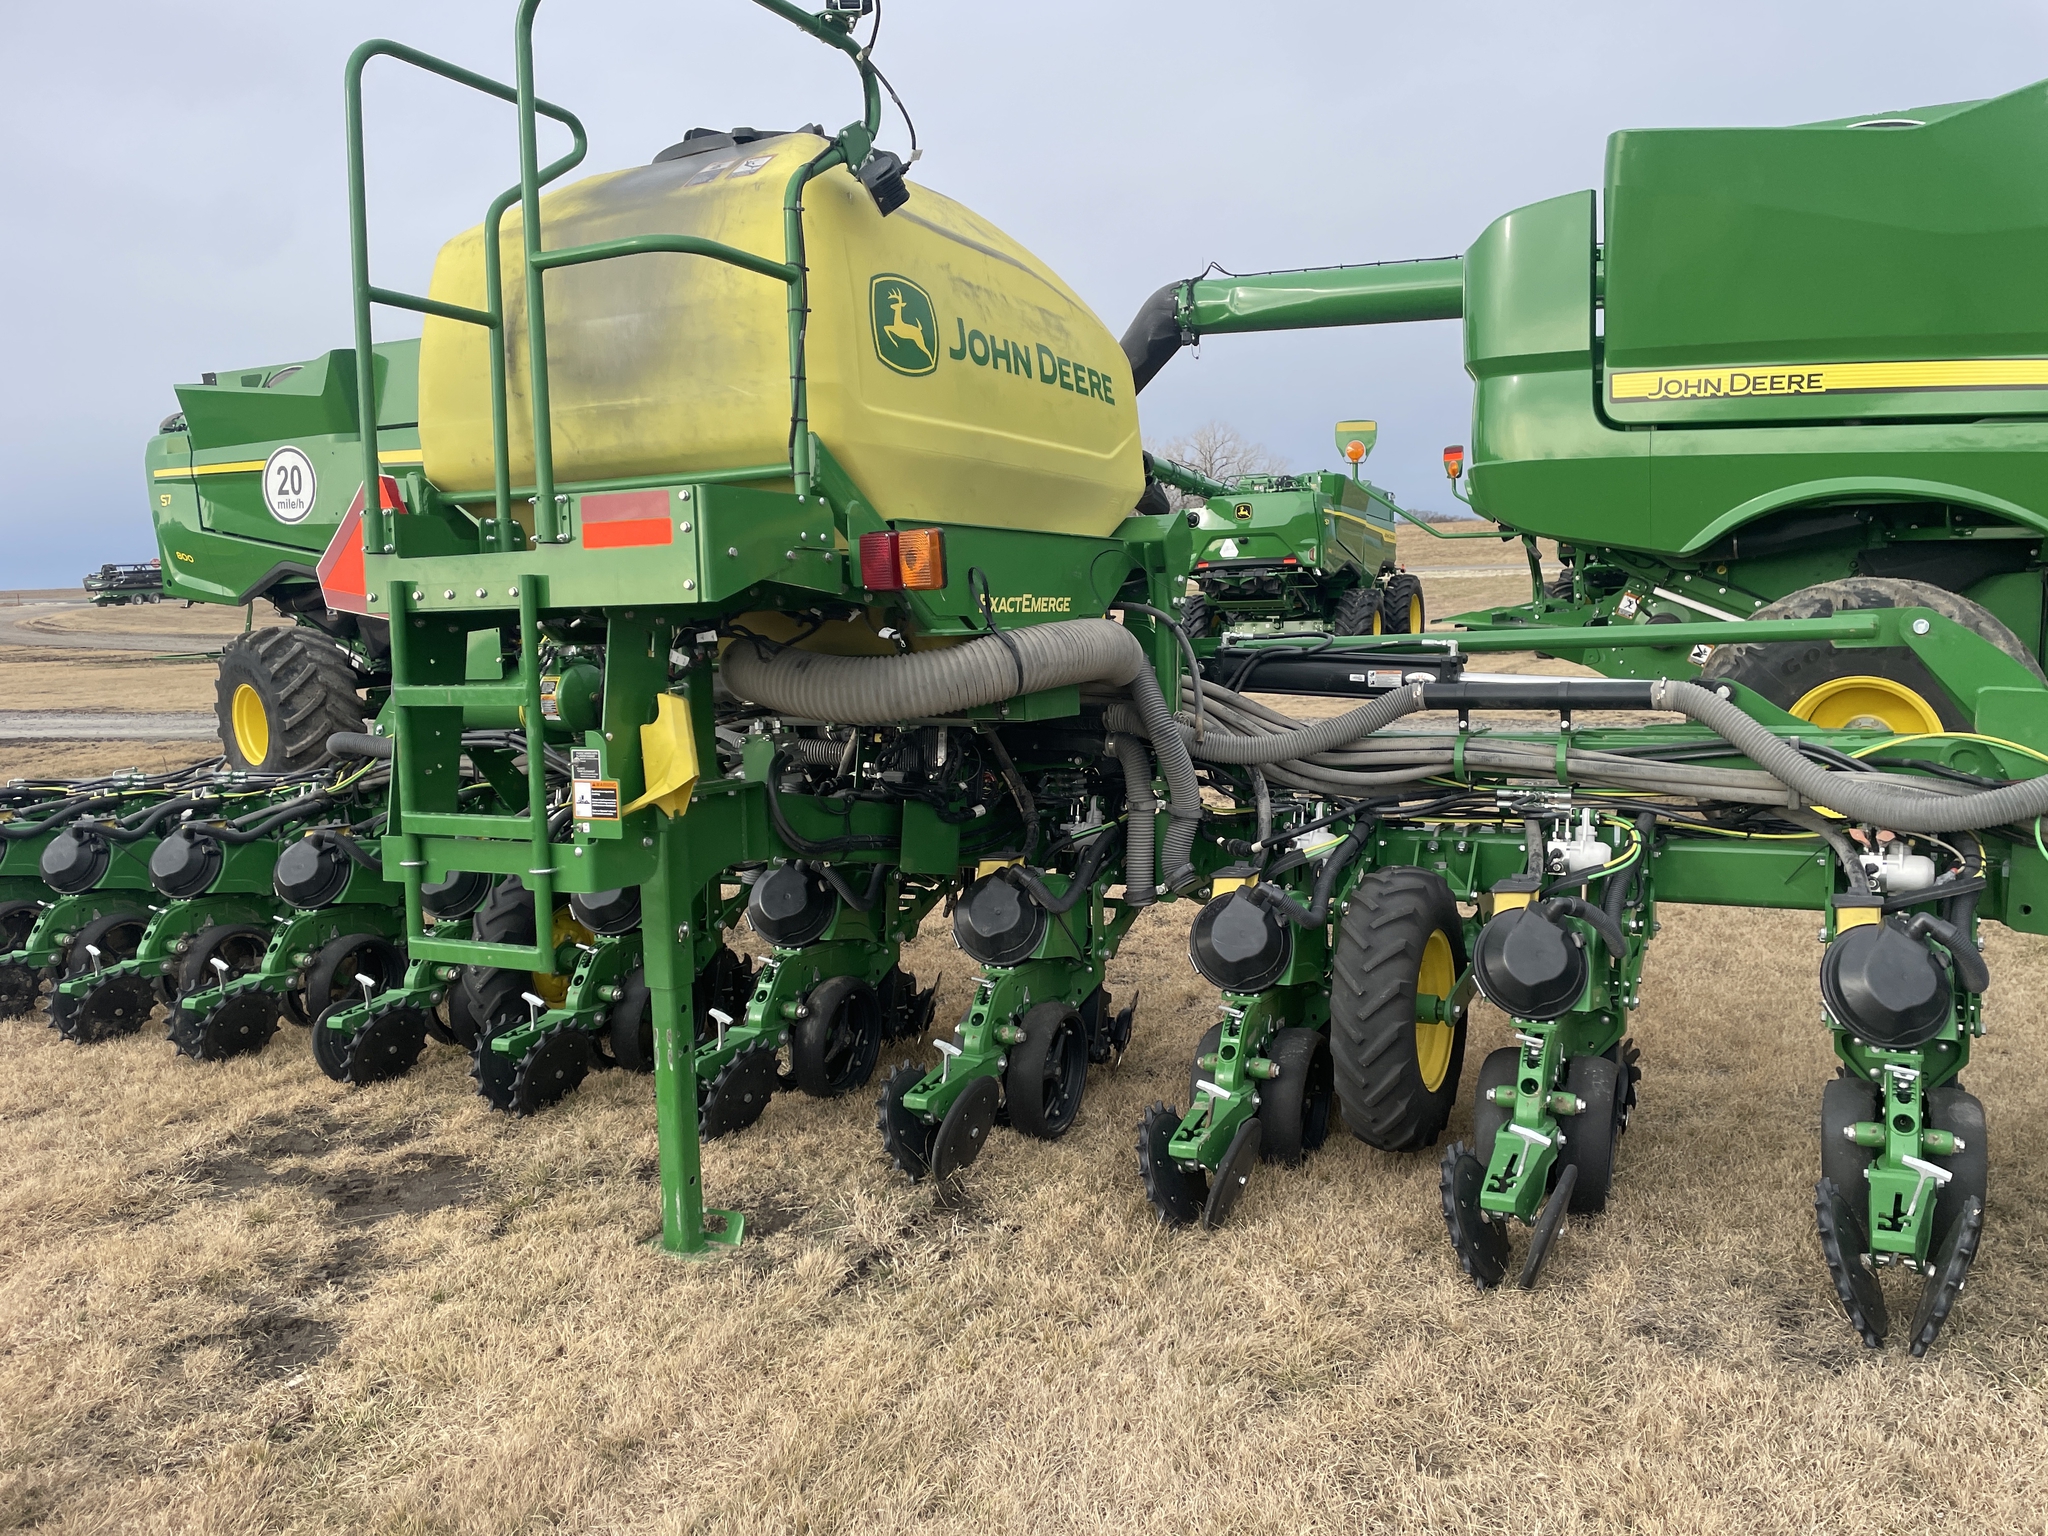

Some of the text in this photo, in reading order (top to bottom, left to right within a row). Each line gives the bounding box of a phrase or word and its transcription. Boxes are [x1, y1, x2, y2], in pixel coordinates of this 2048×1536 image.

[949, 317, 1116, 406] JOHN DEERE
[1648, 373, 1823, 397] JOHN DEERE
[277, 465, 302, 495] 20
[160, 494, 171, 507] S7
[278, 499, 304, 509] mile/h
